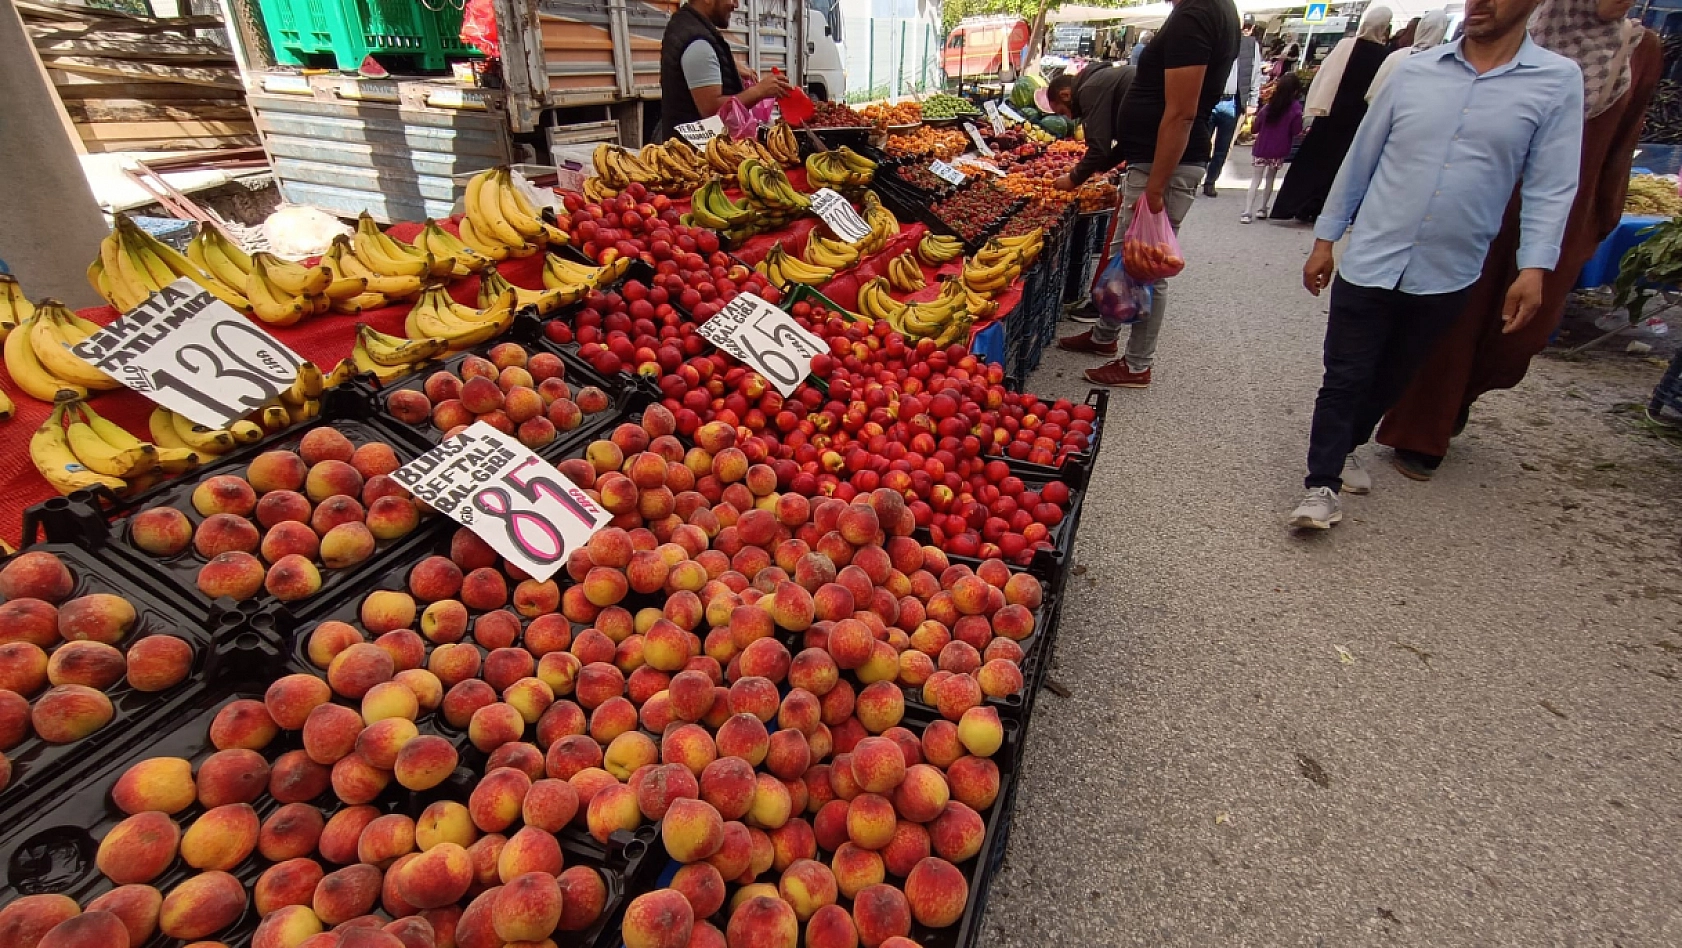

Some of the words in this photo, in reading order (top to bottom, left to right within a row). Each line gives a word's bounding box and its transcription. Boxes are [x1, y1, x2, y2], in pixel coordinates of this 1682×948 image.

[150, 319, 302, 428] 130
[738, 308, 823, 386] 65
[393, 432, 476, 486] BURSA
[472, 455, 597, 566] 85
